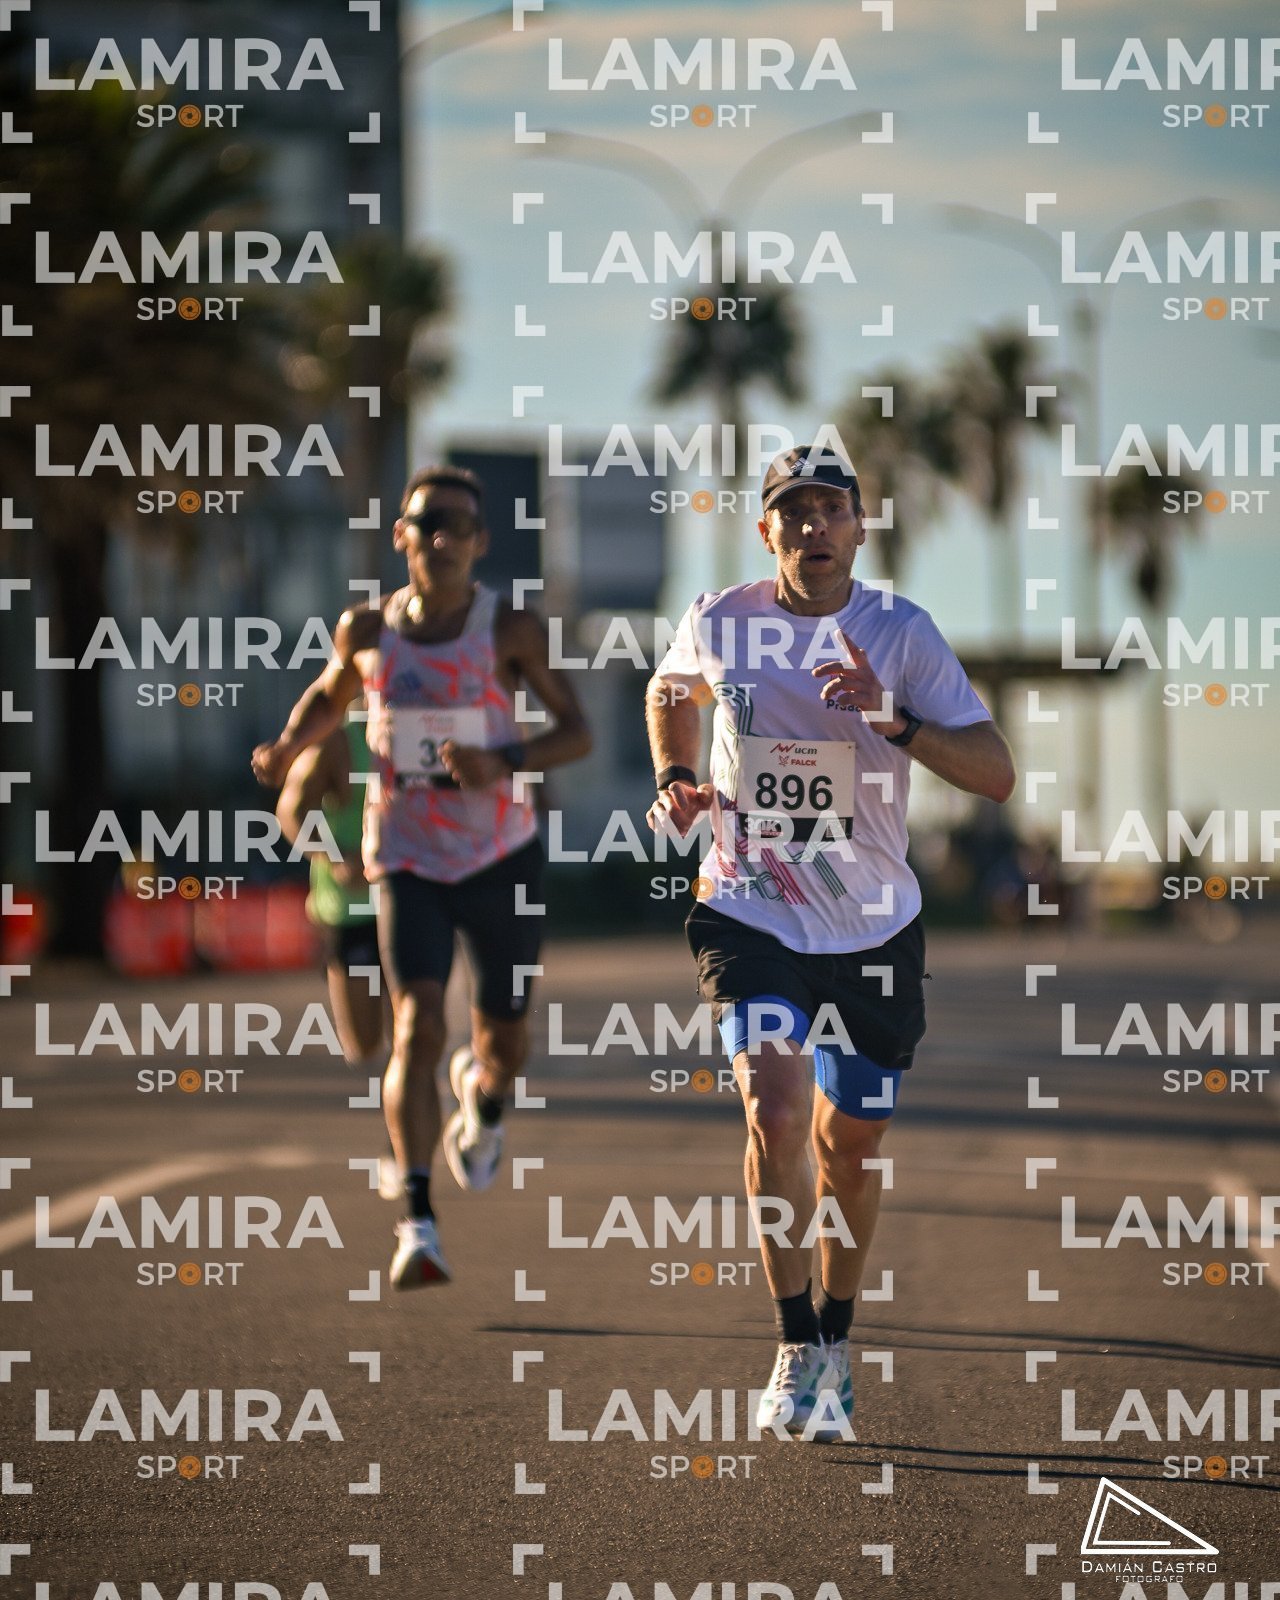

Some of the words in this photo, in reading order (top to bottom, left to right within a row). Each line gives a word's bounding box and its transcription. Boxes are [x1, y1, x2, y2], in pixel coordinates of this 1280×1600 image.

[795, 747, 818, 755] ucm
[791, 759, 817, 767] FALCK
[755, 772, 833, 811] 896
